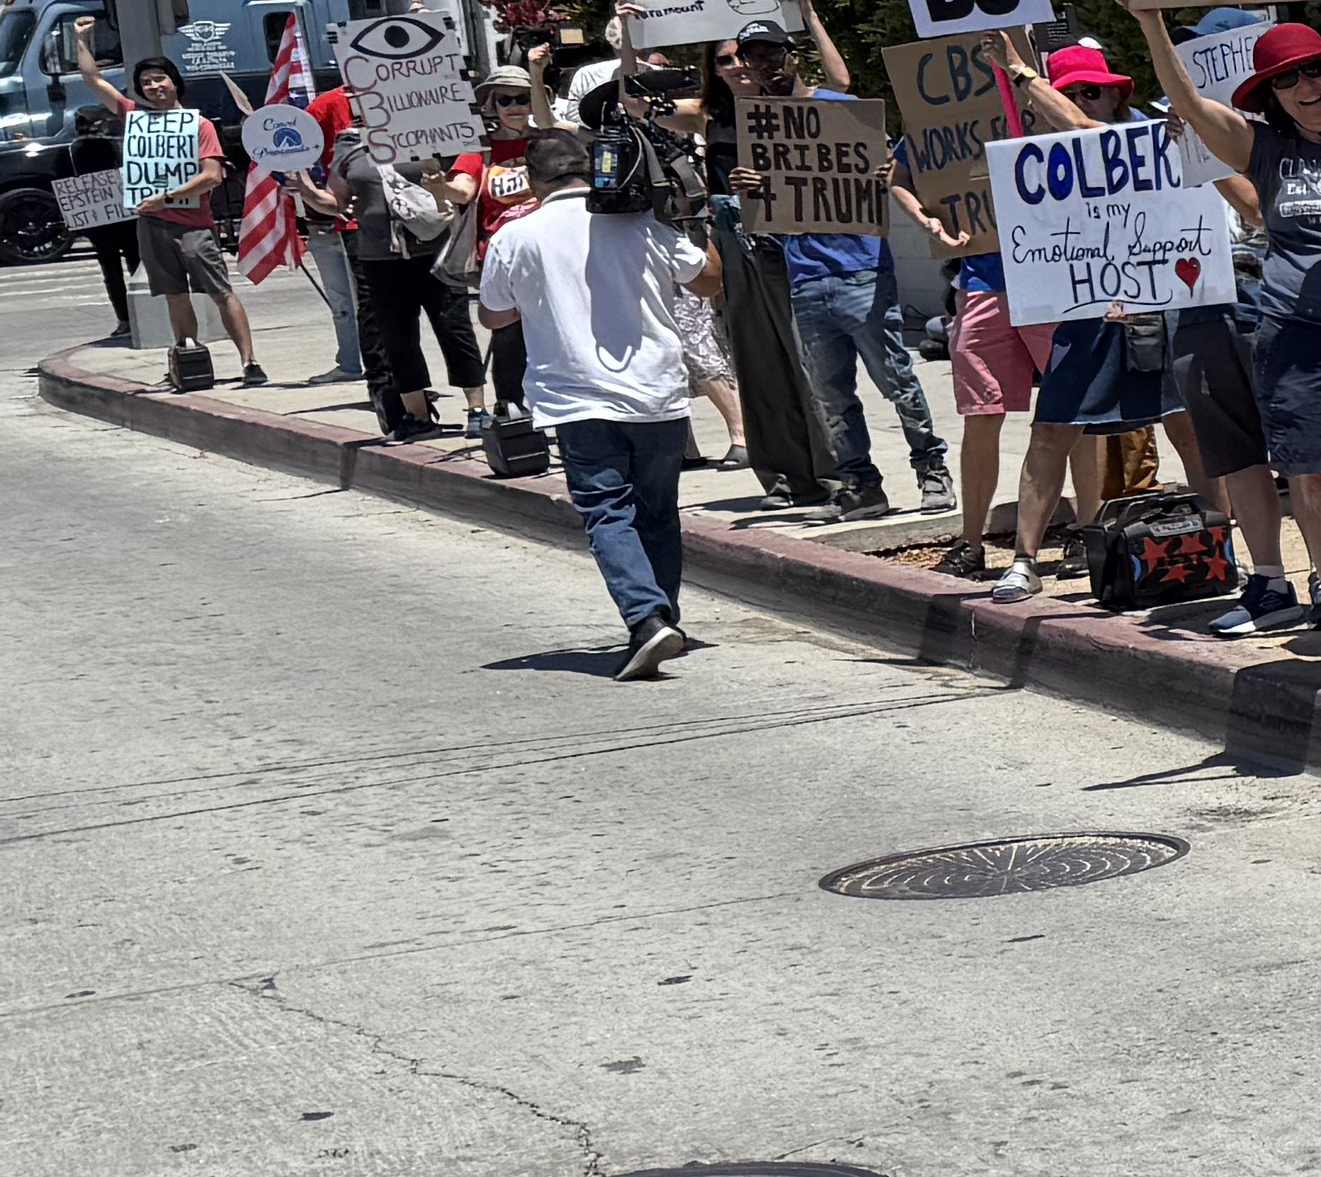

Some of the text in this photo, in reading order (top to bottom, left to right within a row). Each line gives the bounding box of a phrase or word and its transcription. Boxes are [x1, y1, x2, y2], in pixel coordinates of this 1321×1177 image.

[344, 53, 460, 92] CORRUPT
[917, 44, 996, 105] CBS
[1192, 36, 1258, 89] STEPHE
[127, 112, 195, 134] KEEP
[350, 82, 466, 129] BILLIONAIRE
[747, 104, 822, 140] #NO
[127, 134, 195, 159] COLBERT
[751, 141, 871, 173] BRIBES
[904, 120, 985, 173] WORKS
[1014, 122, 1202, 205] COLBER
[55, 173, 117, 195] RELEASE
[126, 160, 197, 185] DUMP
[59, 188, 114, 212] EPSTEIN
[106, 203, 136, 220] FIL
[747, 176, 777, 222] 4
[1086, 202, 1131, 229] is my
[1012, 211, 1212, 264] Emotional Support
[1069, 259, 1169, 304] HOST
